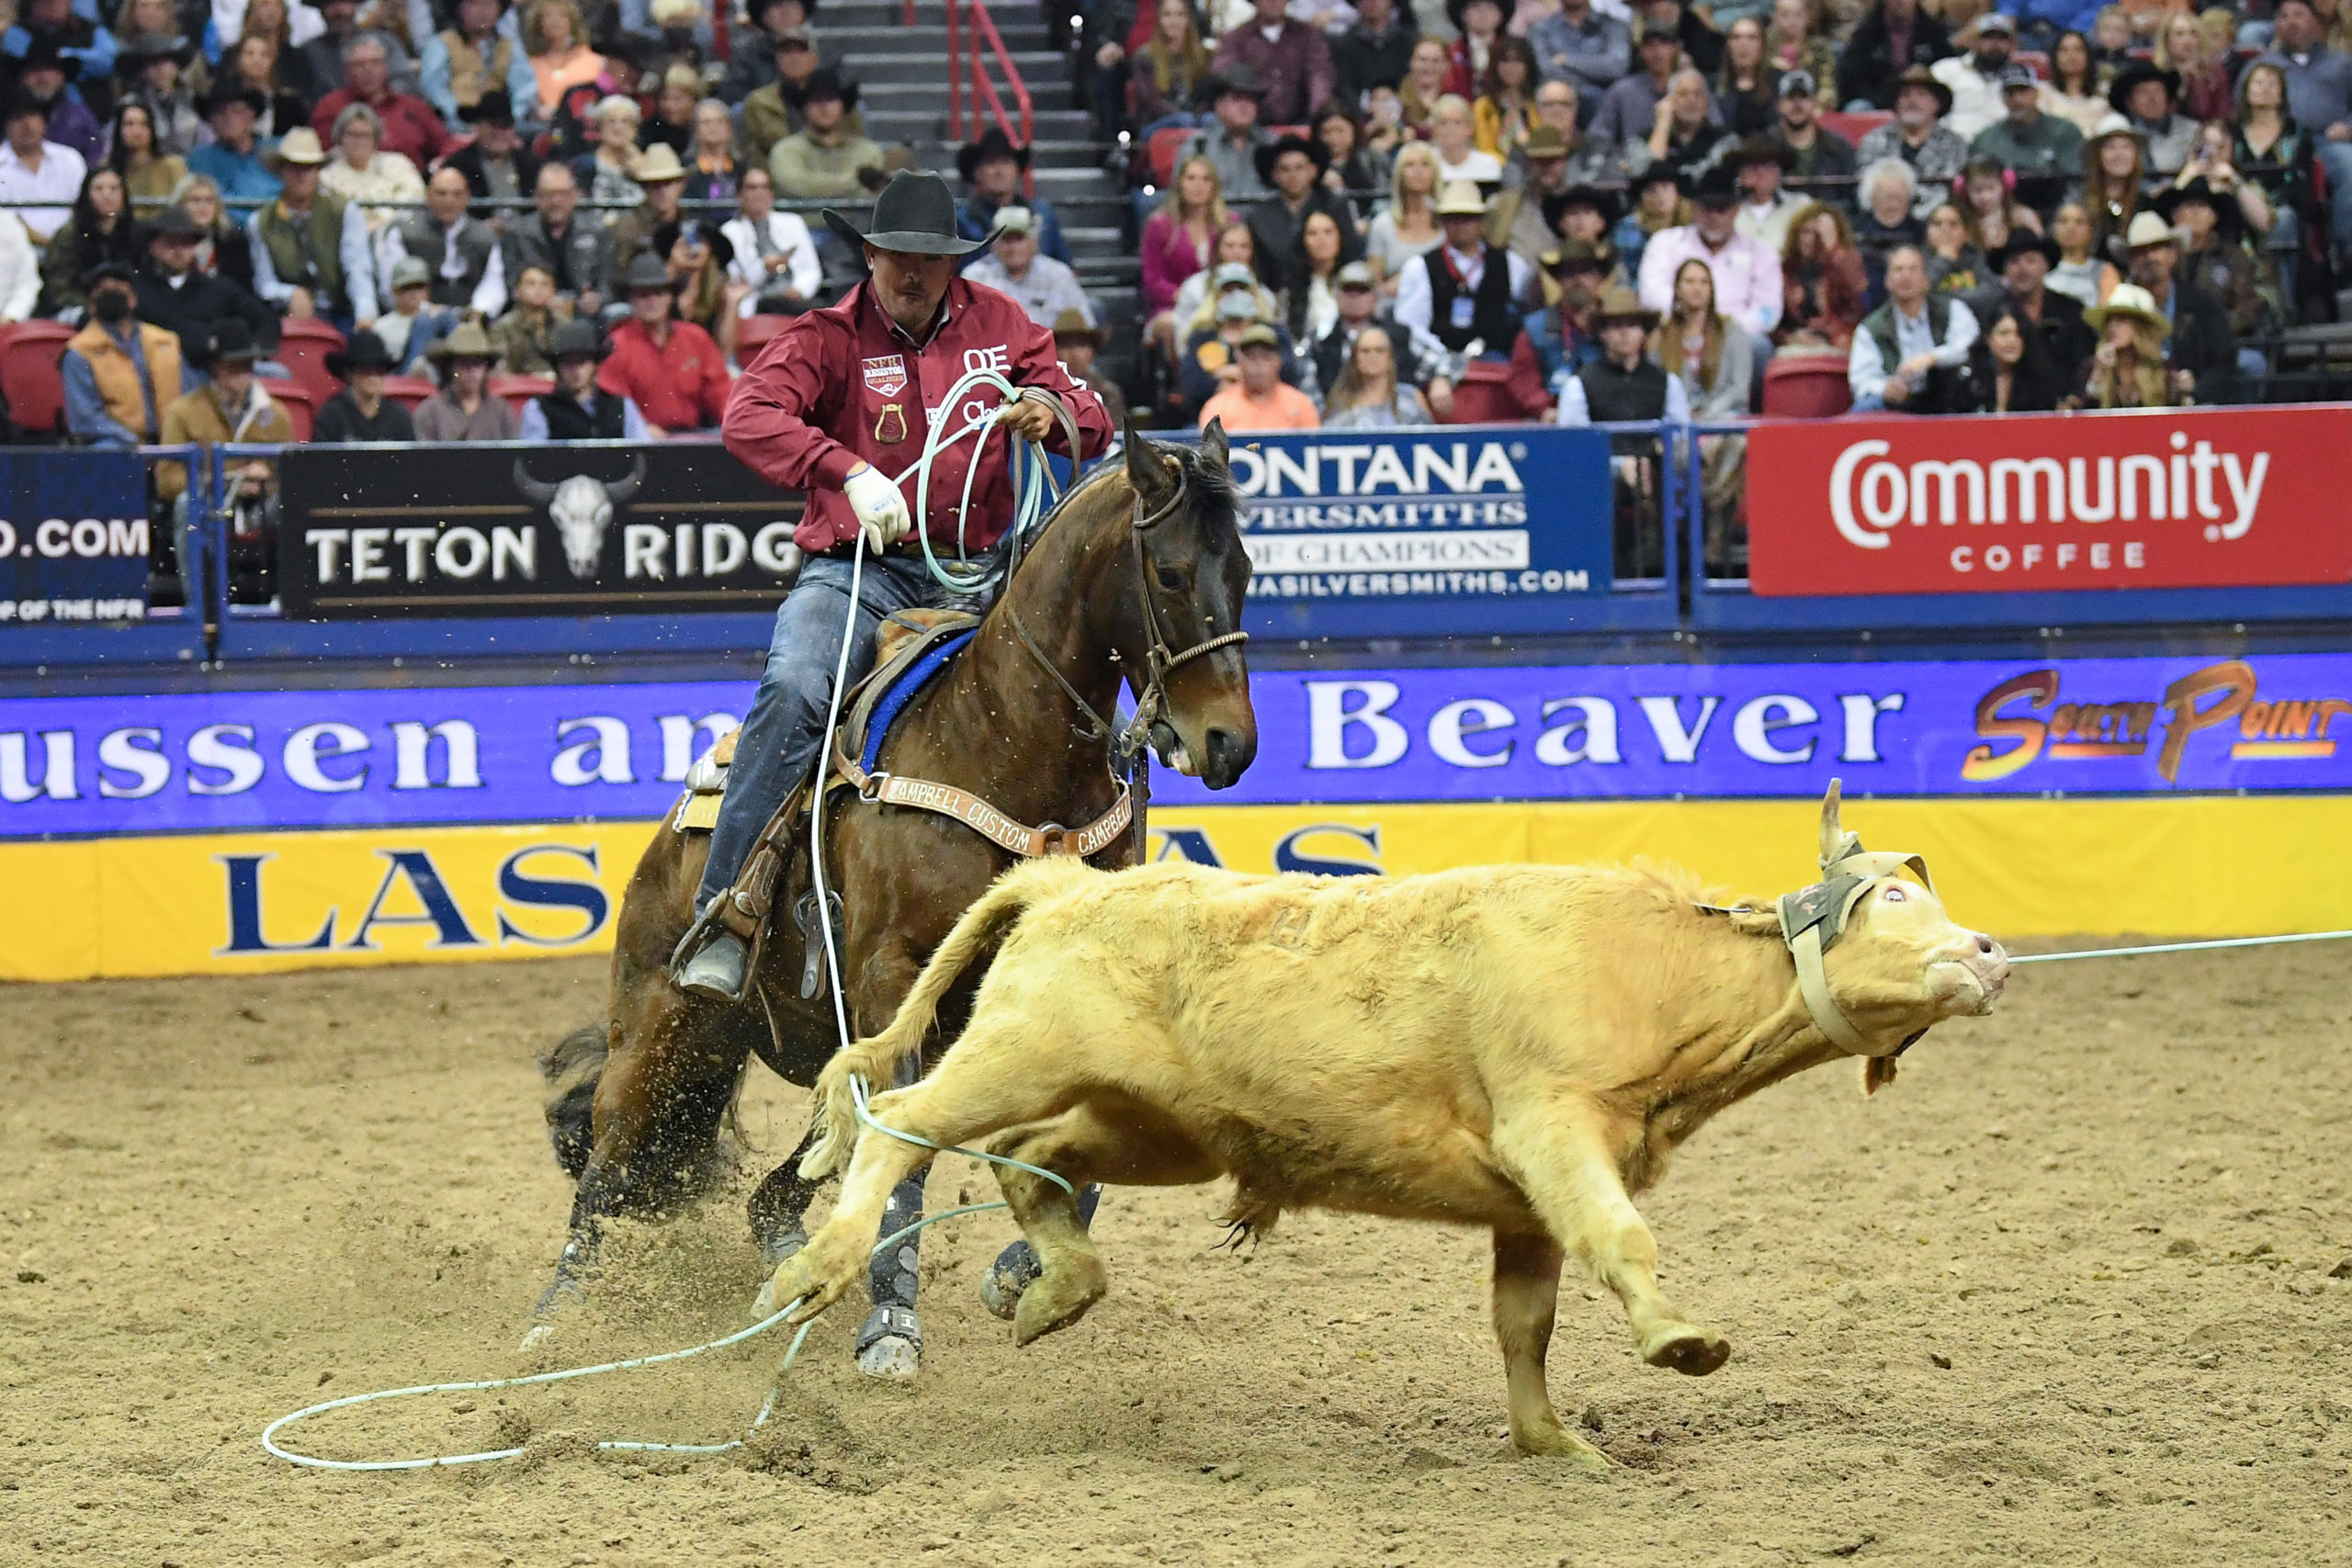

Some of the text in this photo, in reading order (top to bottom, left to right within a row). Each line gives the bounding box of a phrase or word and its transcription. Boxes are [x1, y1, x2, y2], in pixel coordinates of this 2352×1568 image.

[868, 357, 898, 368] NFR
[1828, 430, 2269, 549] Community
[305, 525, 538, 583] TETON
[1296, 535, 1516, 562] CHAMPIONS
[1951, 541, 2144, 572] COFFEE
[18, 598, 50, 622] OF
[51, 598, 93, 621] THE
[95, 598, 145, 621] NFR
[0, 720, 484, 803] ussen
[1304, 680, 1905, 769] Beaver
[888, 779, 1132, 853] CAMPBELL CUSTOM CAMPBELL
[212, 844, 610, 955] LAS
